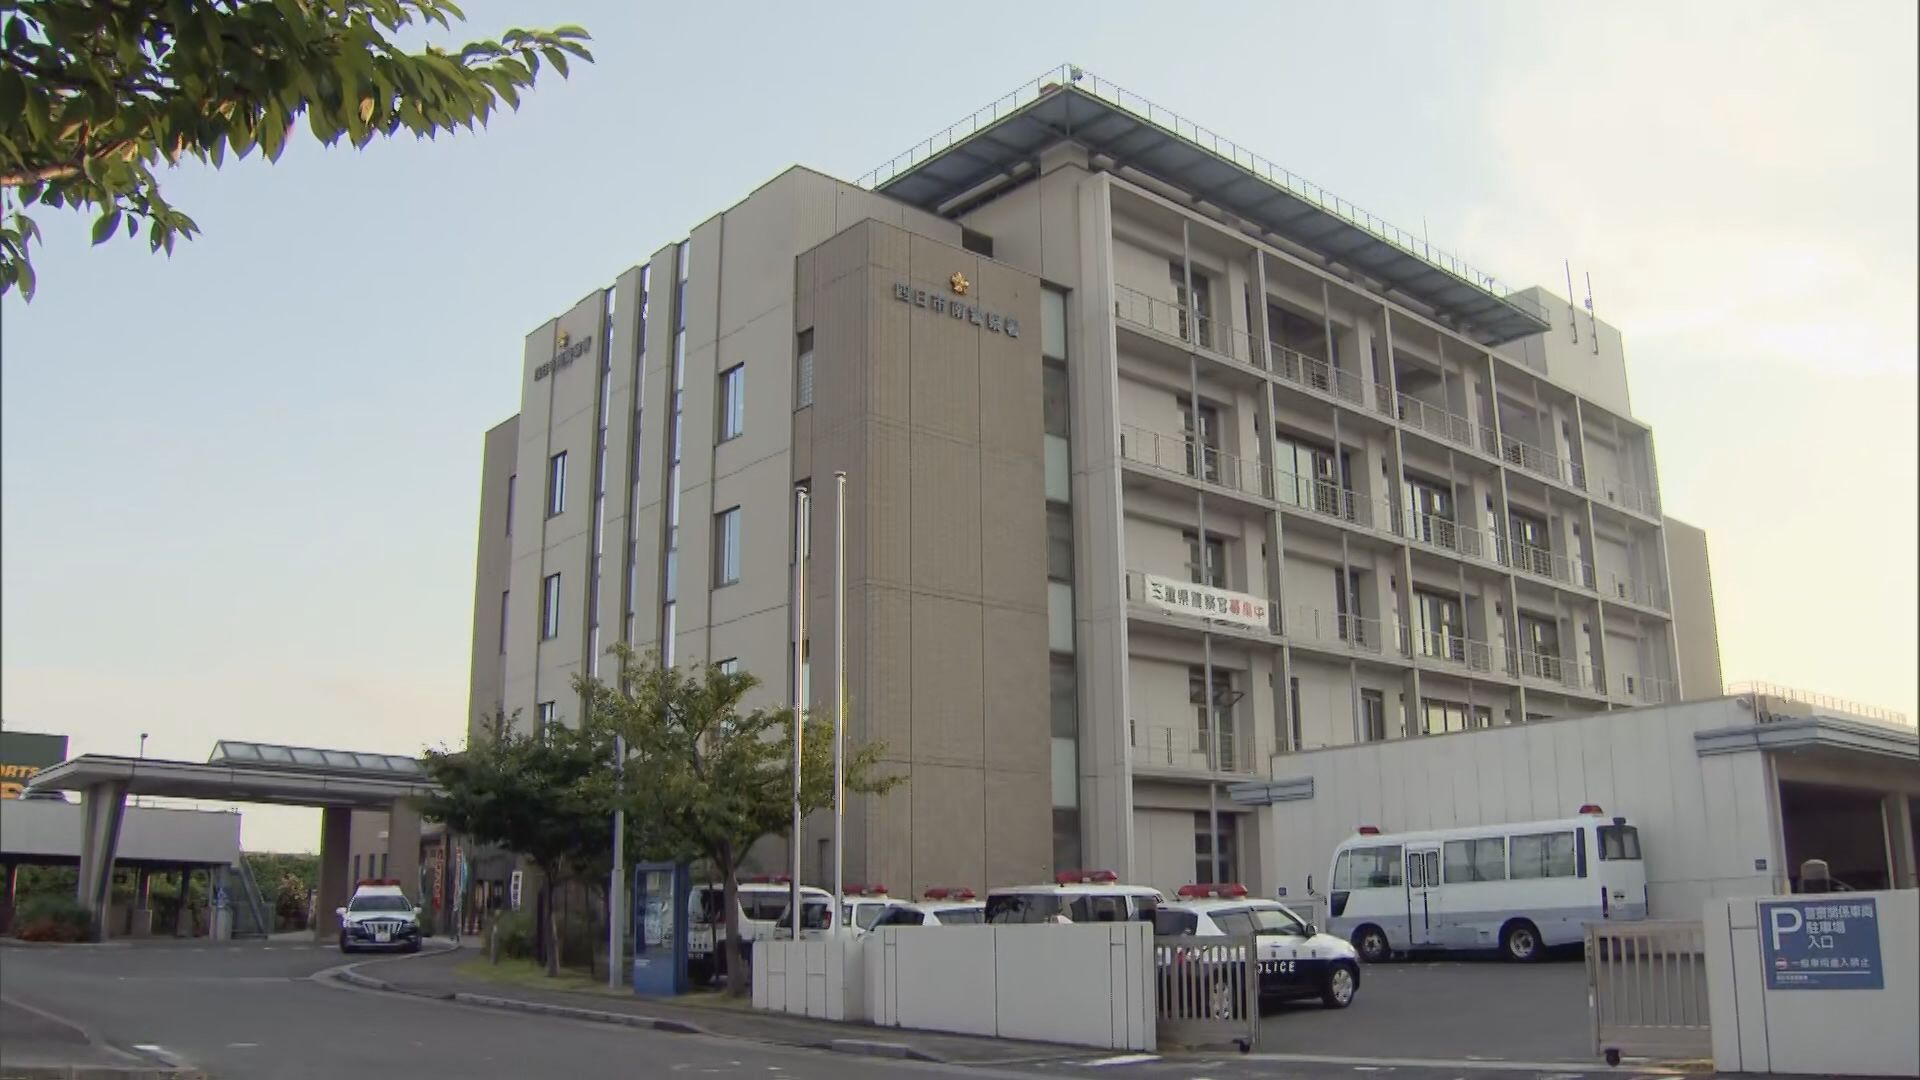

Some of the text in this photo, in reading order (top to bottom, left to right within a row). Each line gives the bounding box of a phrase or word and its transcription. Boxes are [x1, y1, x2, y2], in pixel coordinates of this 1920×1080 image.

[1771, 907, 1802, 950] P
[1806, 921, 1846, 934] 駐車場
[1808, 935, 1834, 949] 入口
[1257, 961, 1295, 974] OLICE
